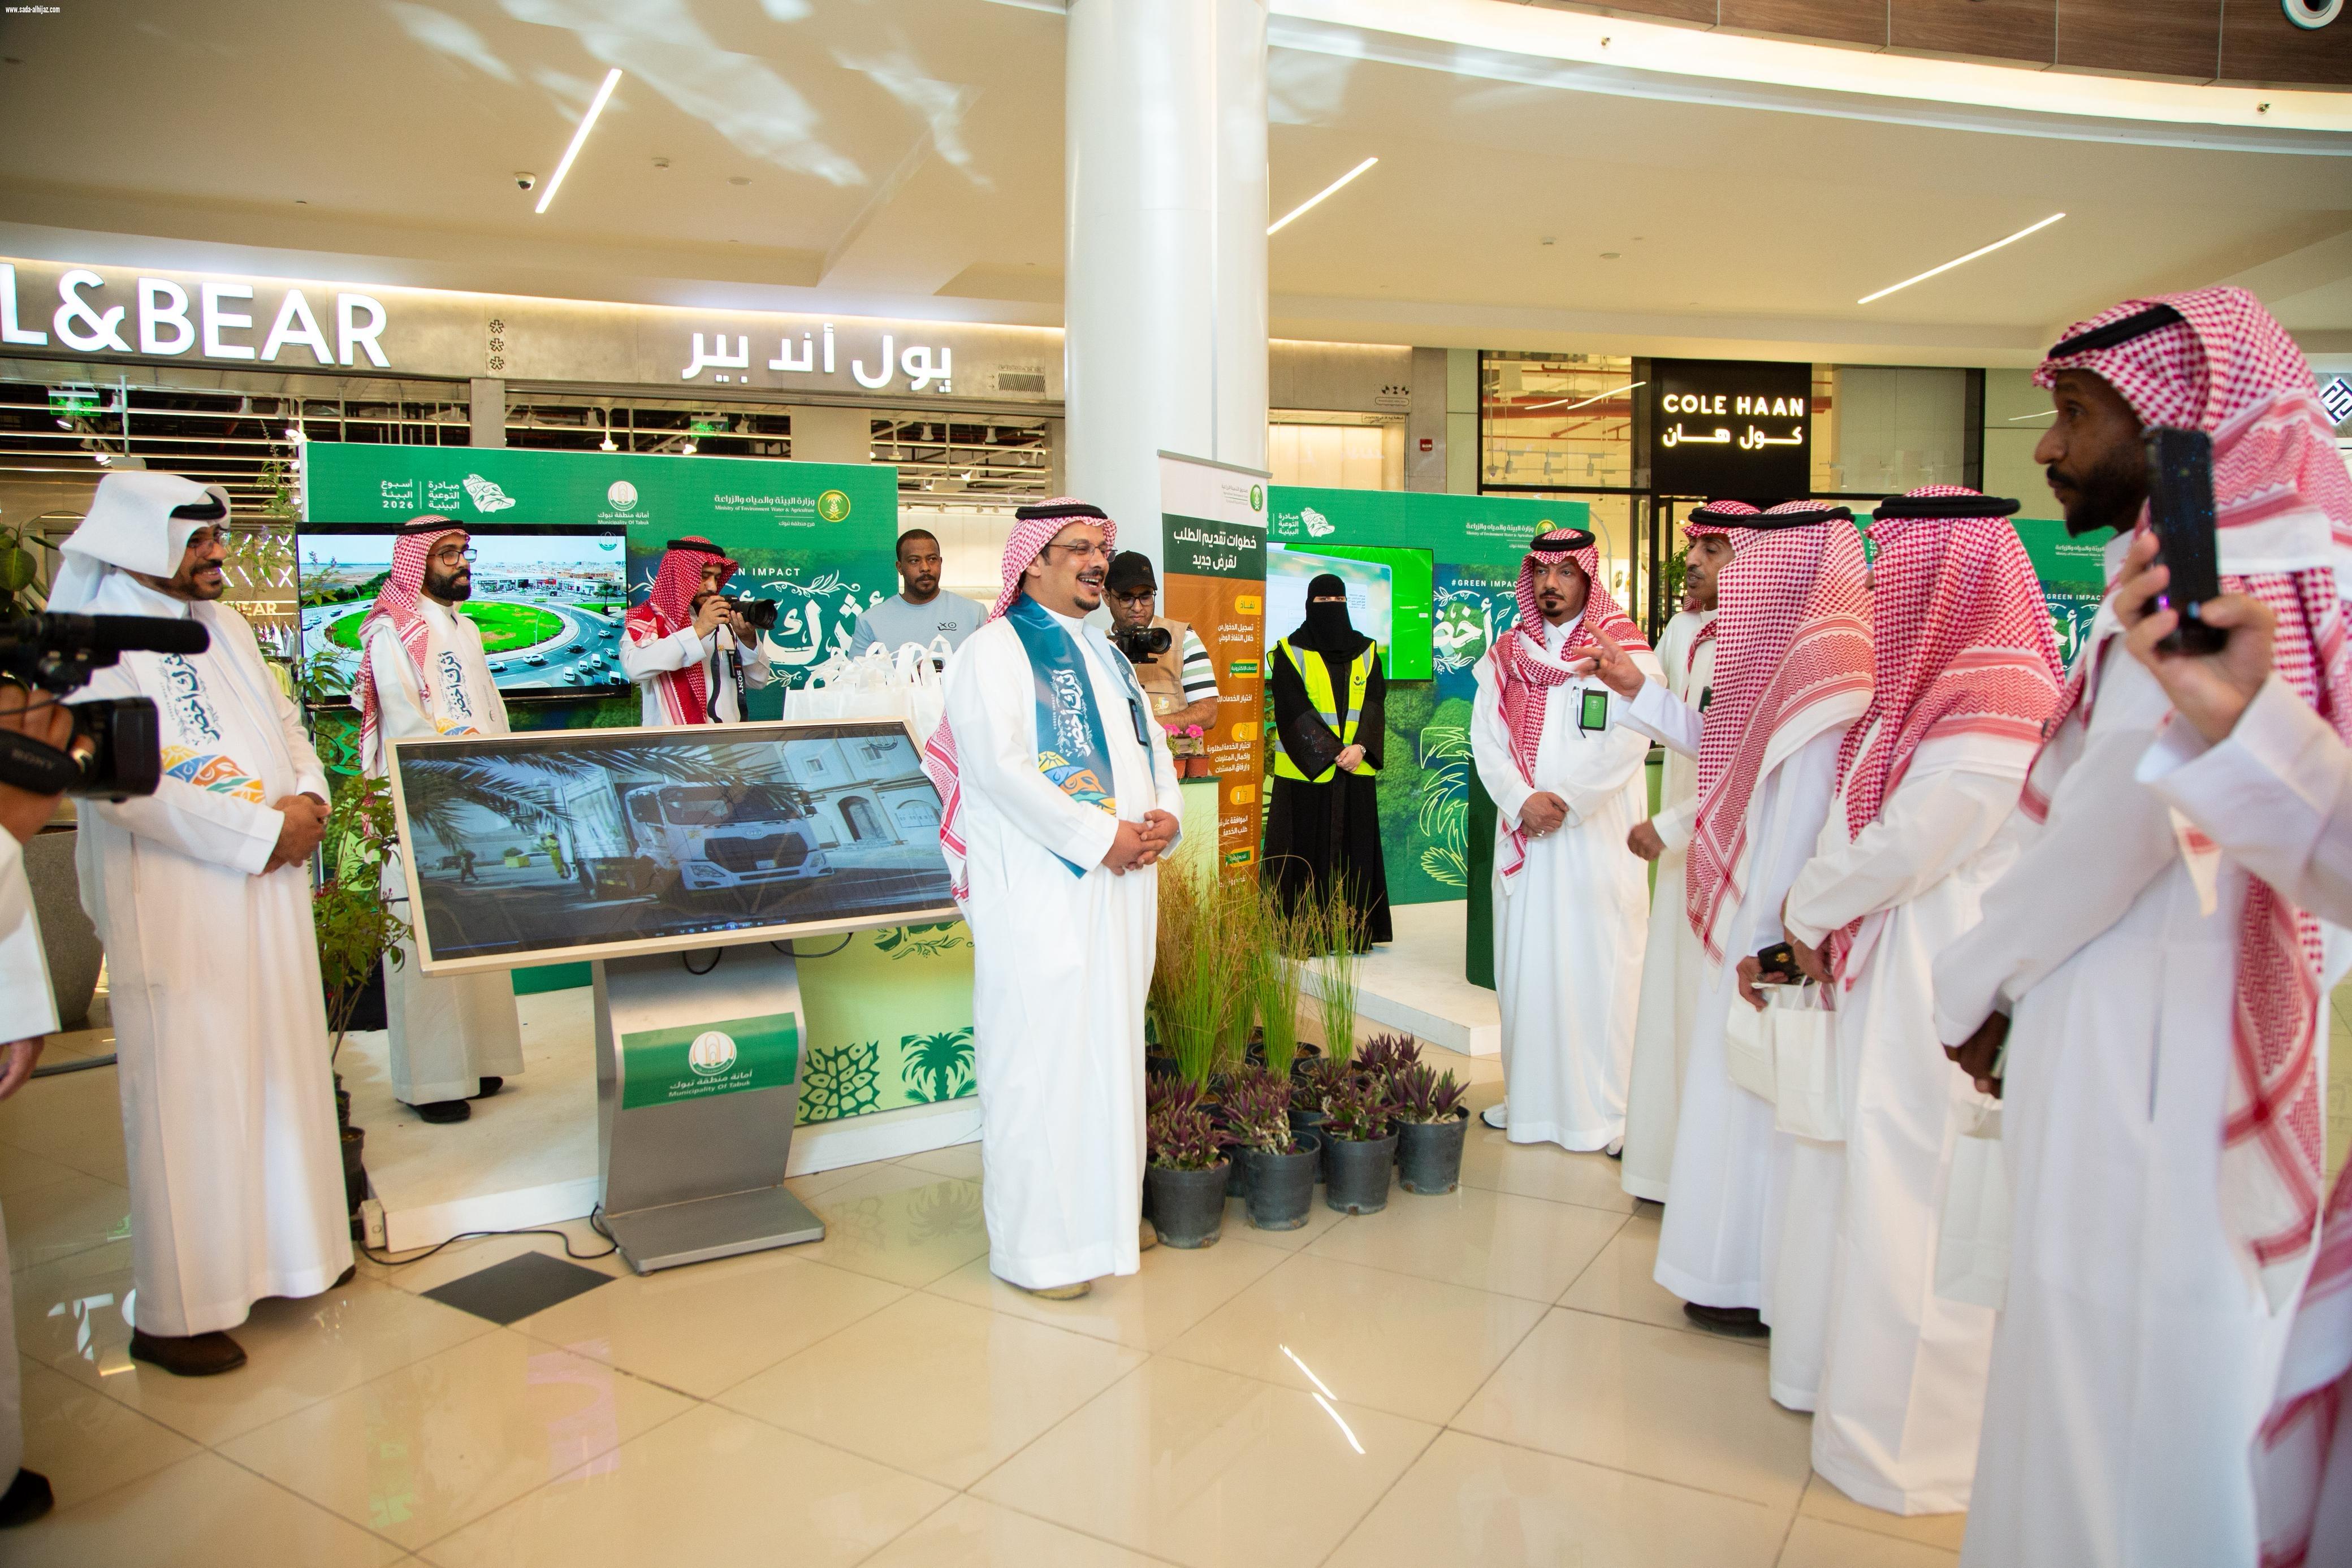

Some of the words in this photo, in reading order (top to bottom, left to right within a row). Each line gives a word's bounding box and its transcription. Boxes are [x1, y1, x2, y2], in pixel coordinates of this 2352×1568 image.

[768, 322, 835, 373] أند
[681, 332, 749, 384] بير
[1663, 394, 1727, 415] COLE
[1736, 396, 1804, 417] HAAN
[1662, 423, 1731, 447] هان
[1739, 425, 1802, 449] كول
[381, 479, 413, 490] أسبوع
[428, 481, 460, 490] مبادرة
[382, 491, 413, 500] البيئة
[428, 491, 460, 501] التوعية
[714, 495, 744, 504] والزراعة
[746, 495, 773, 505] والمياه
[428, 501, 460, 510] البيئية
[775, 496, 795, 506] البيئة
[797, 497, 815, 506] وزارة
[1466, 522, 1487, 531] والزراعة
[1506, 523, 1521, 532] البيئة
[1521, 524, 1534, 532] وزارة
[1173, 527, 1201, 545] الطلب
[1202, 531, 1226, 548] تقديم
[1227, 534, 1256, 551] خطوات
[1192, 554, 1212, 570] جديد
[1213, 554, 1237, 571] لقرض
[1451, 579, 1486, 587] #GREEN
[1240, 600, 1255, 609] نفاذ
[1223, 623, 1238, 632] الدخول
[1238, 623, 1254, 633] تسجيل
[1218, 633, 1230, 644] الوطني
[1243, 634, 1254, 643] خلال
[1240, 694, 1252, 703] اختيار
[1207, 744, 1224, 754] المطلوبة
[1238, 742, 1251, 751] اختيار
[1214, 753, 1234, 763] المعلومات
[1215, 764, 1235, 773] المستندات
[1230, 815, 1248, 825] الموافقة
[1223, 827, 1238, 836] الخدمة
[1238, 826, 1248, 835] طلب
[730, 1068, 753, 1080] أمانة
[669, 1080, 695, 1090] تبوك
[697, 1075, 728, 1085] منطقة
[668, 1086, 715, 1097] Municipality
[729, 1080, 751, 1089] Tabuk
